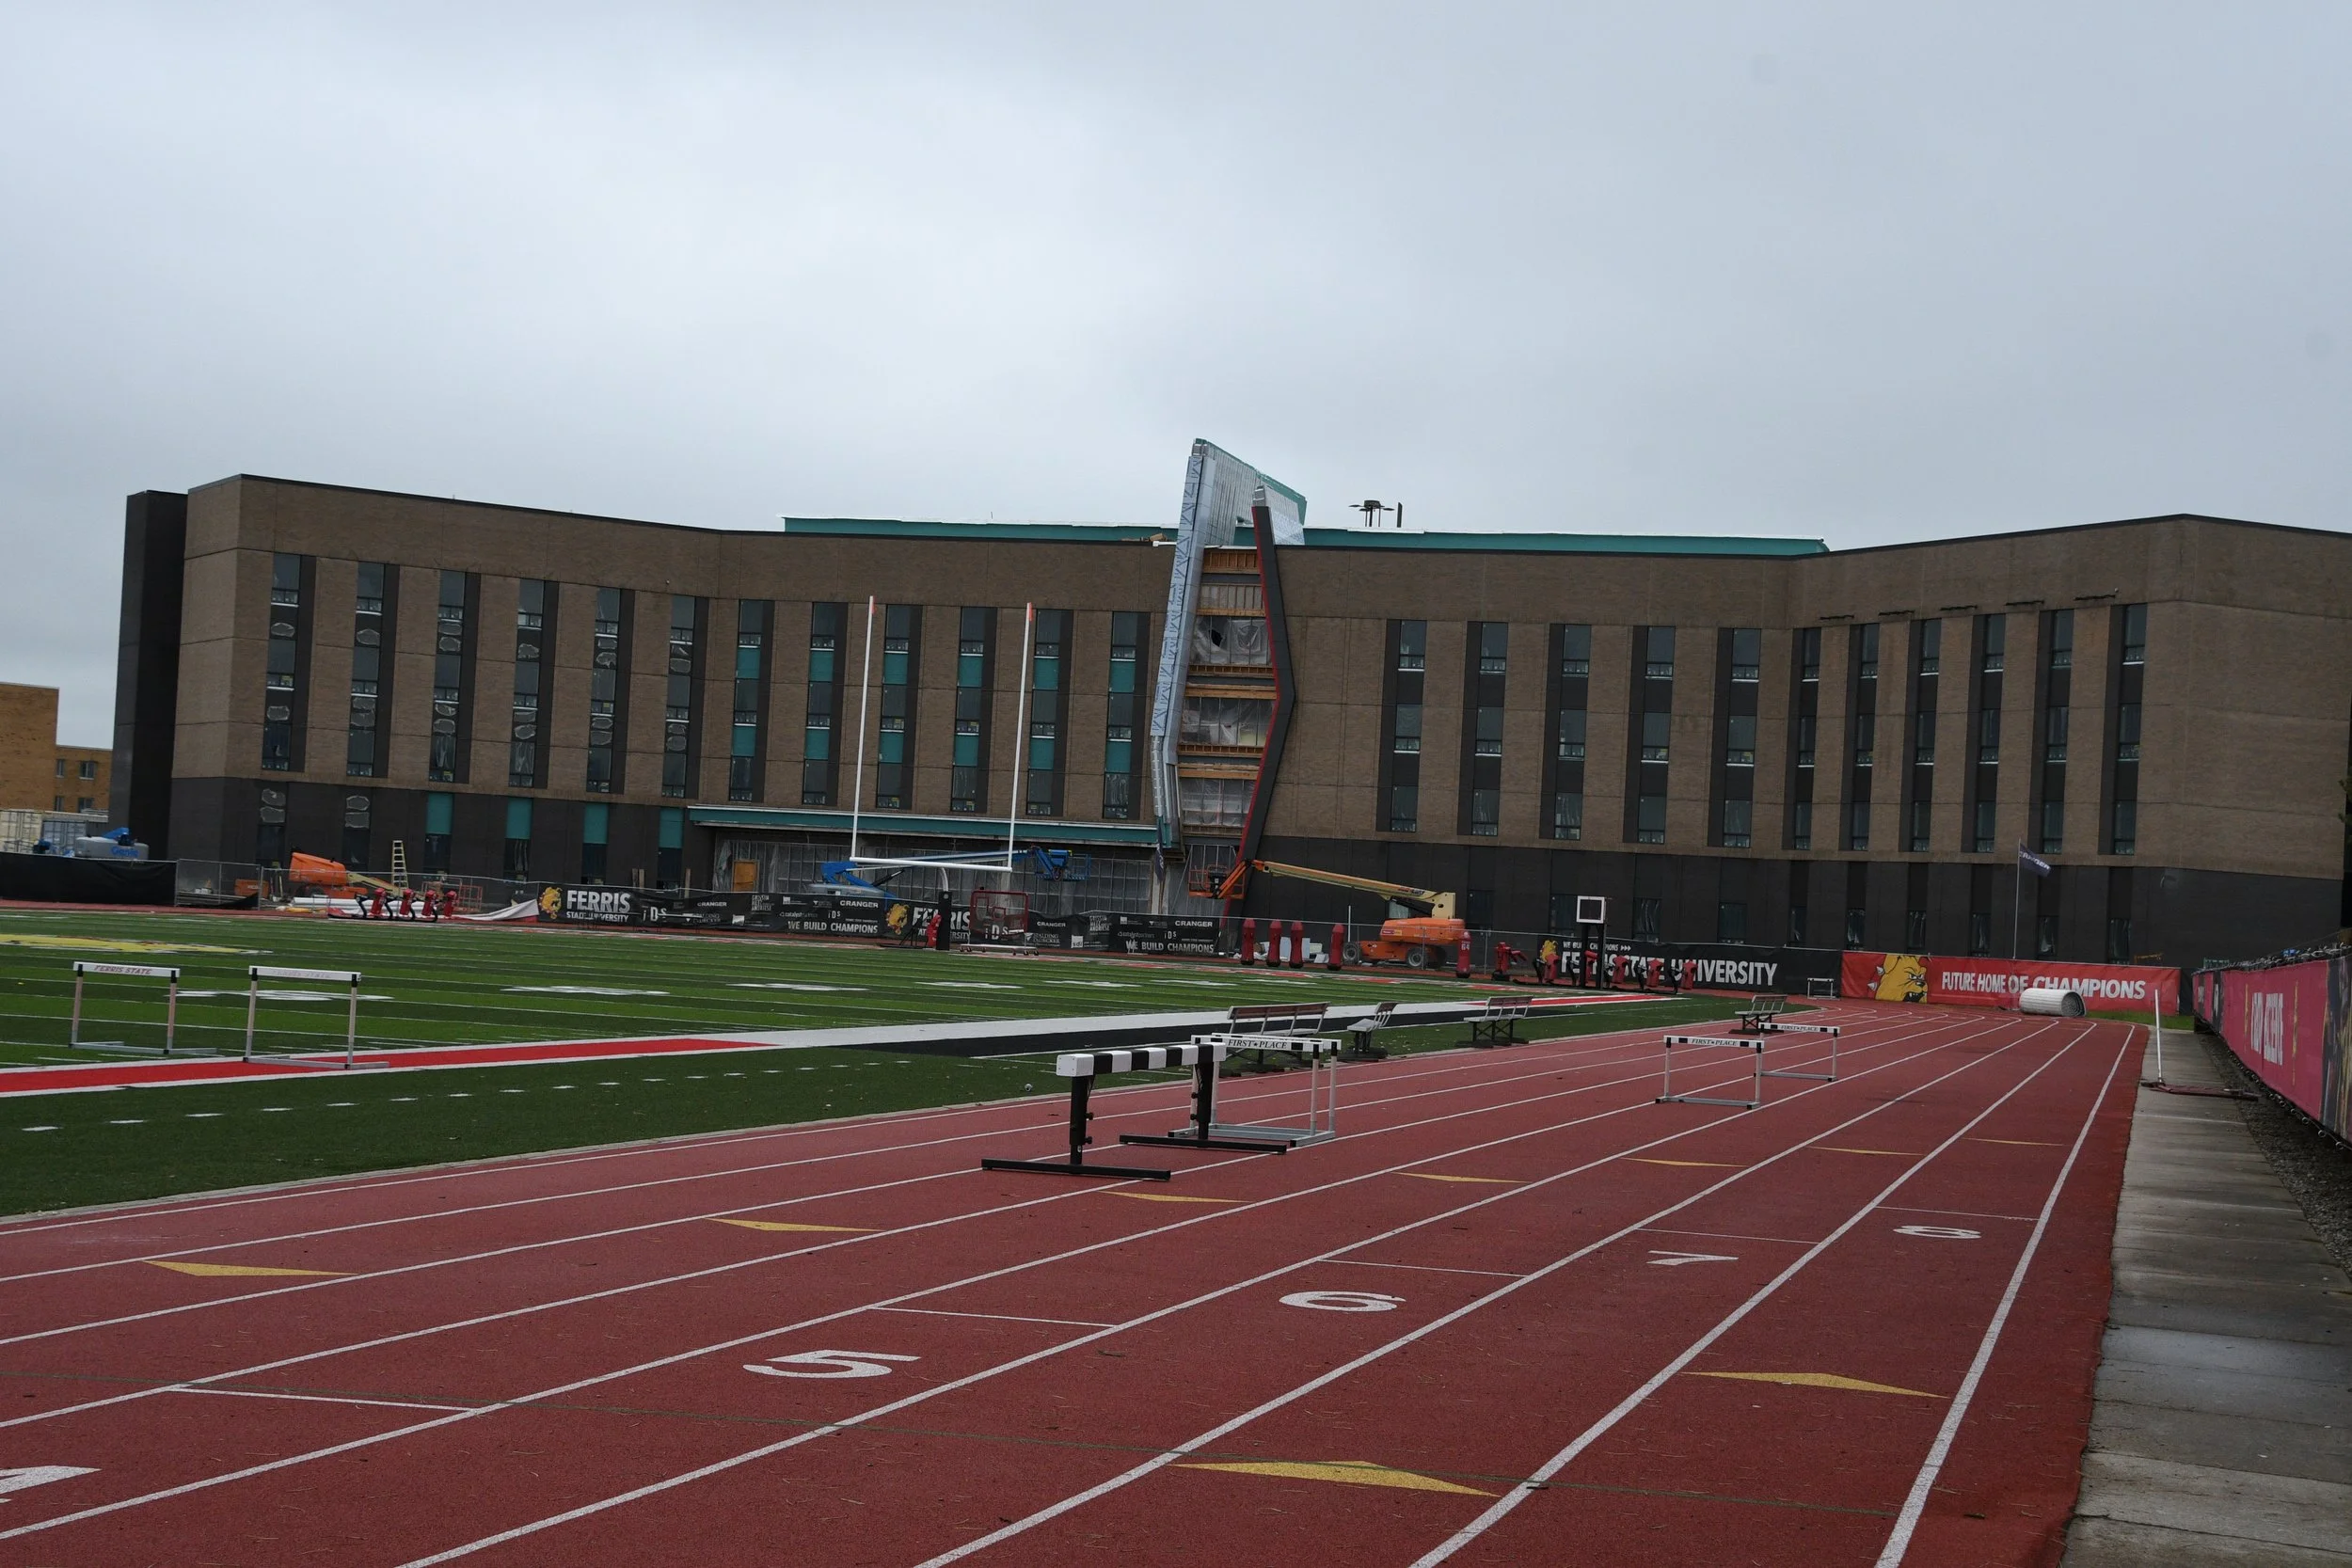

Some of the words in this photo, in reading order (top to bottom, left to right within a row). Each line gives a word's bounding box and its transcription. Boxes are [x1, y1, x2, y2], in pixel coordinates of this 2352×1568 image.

[566, 890, 631, 913] FERRIS
[840, 900, 879, 909] GRANGER
[787, 921, 801, 930] WE
[803, 922, 827, 931] BUILD
[831, 923, 879, 934] CHAMPIONS
[1126, 940, 1138, 950] WE
[1141, 942, 1164, 951] BUILD
[1168, 942, 1214, 954] CHAMPIONS
[1671, 958, 1777, 986] UIVERSITY
[1941, 972, 1976, 990] FUTURE
[1977, 973, 2006, 993] HOME
[2008, 974, 2029, 993] OF
[2032, 975, 2146, 1000] CHAMPIONS
[1228, 1038, 1252, 1047] FIRST
[1259, 1041, 1287, 1050] PLACE
[1646, 1249, 1739, 1266] 7
[1279, 1291, 1407, 1313] 6
[742, 1349, 921, 1379] 5
